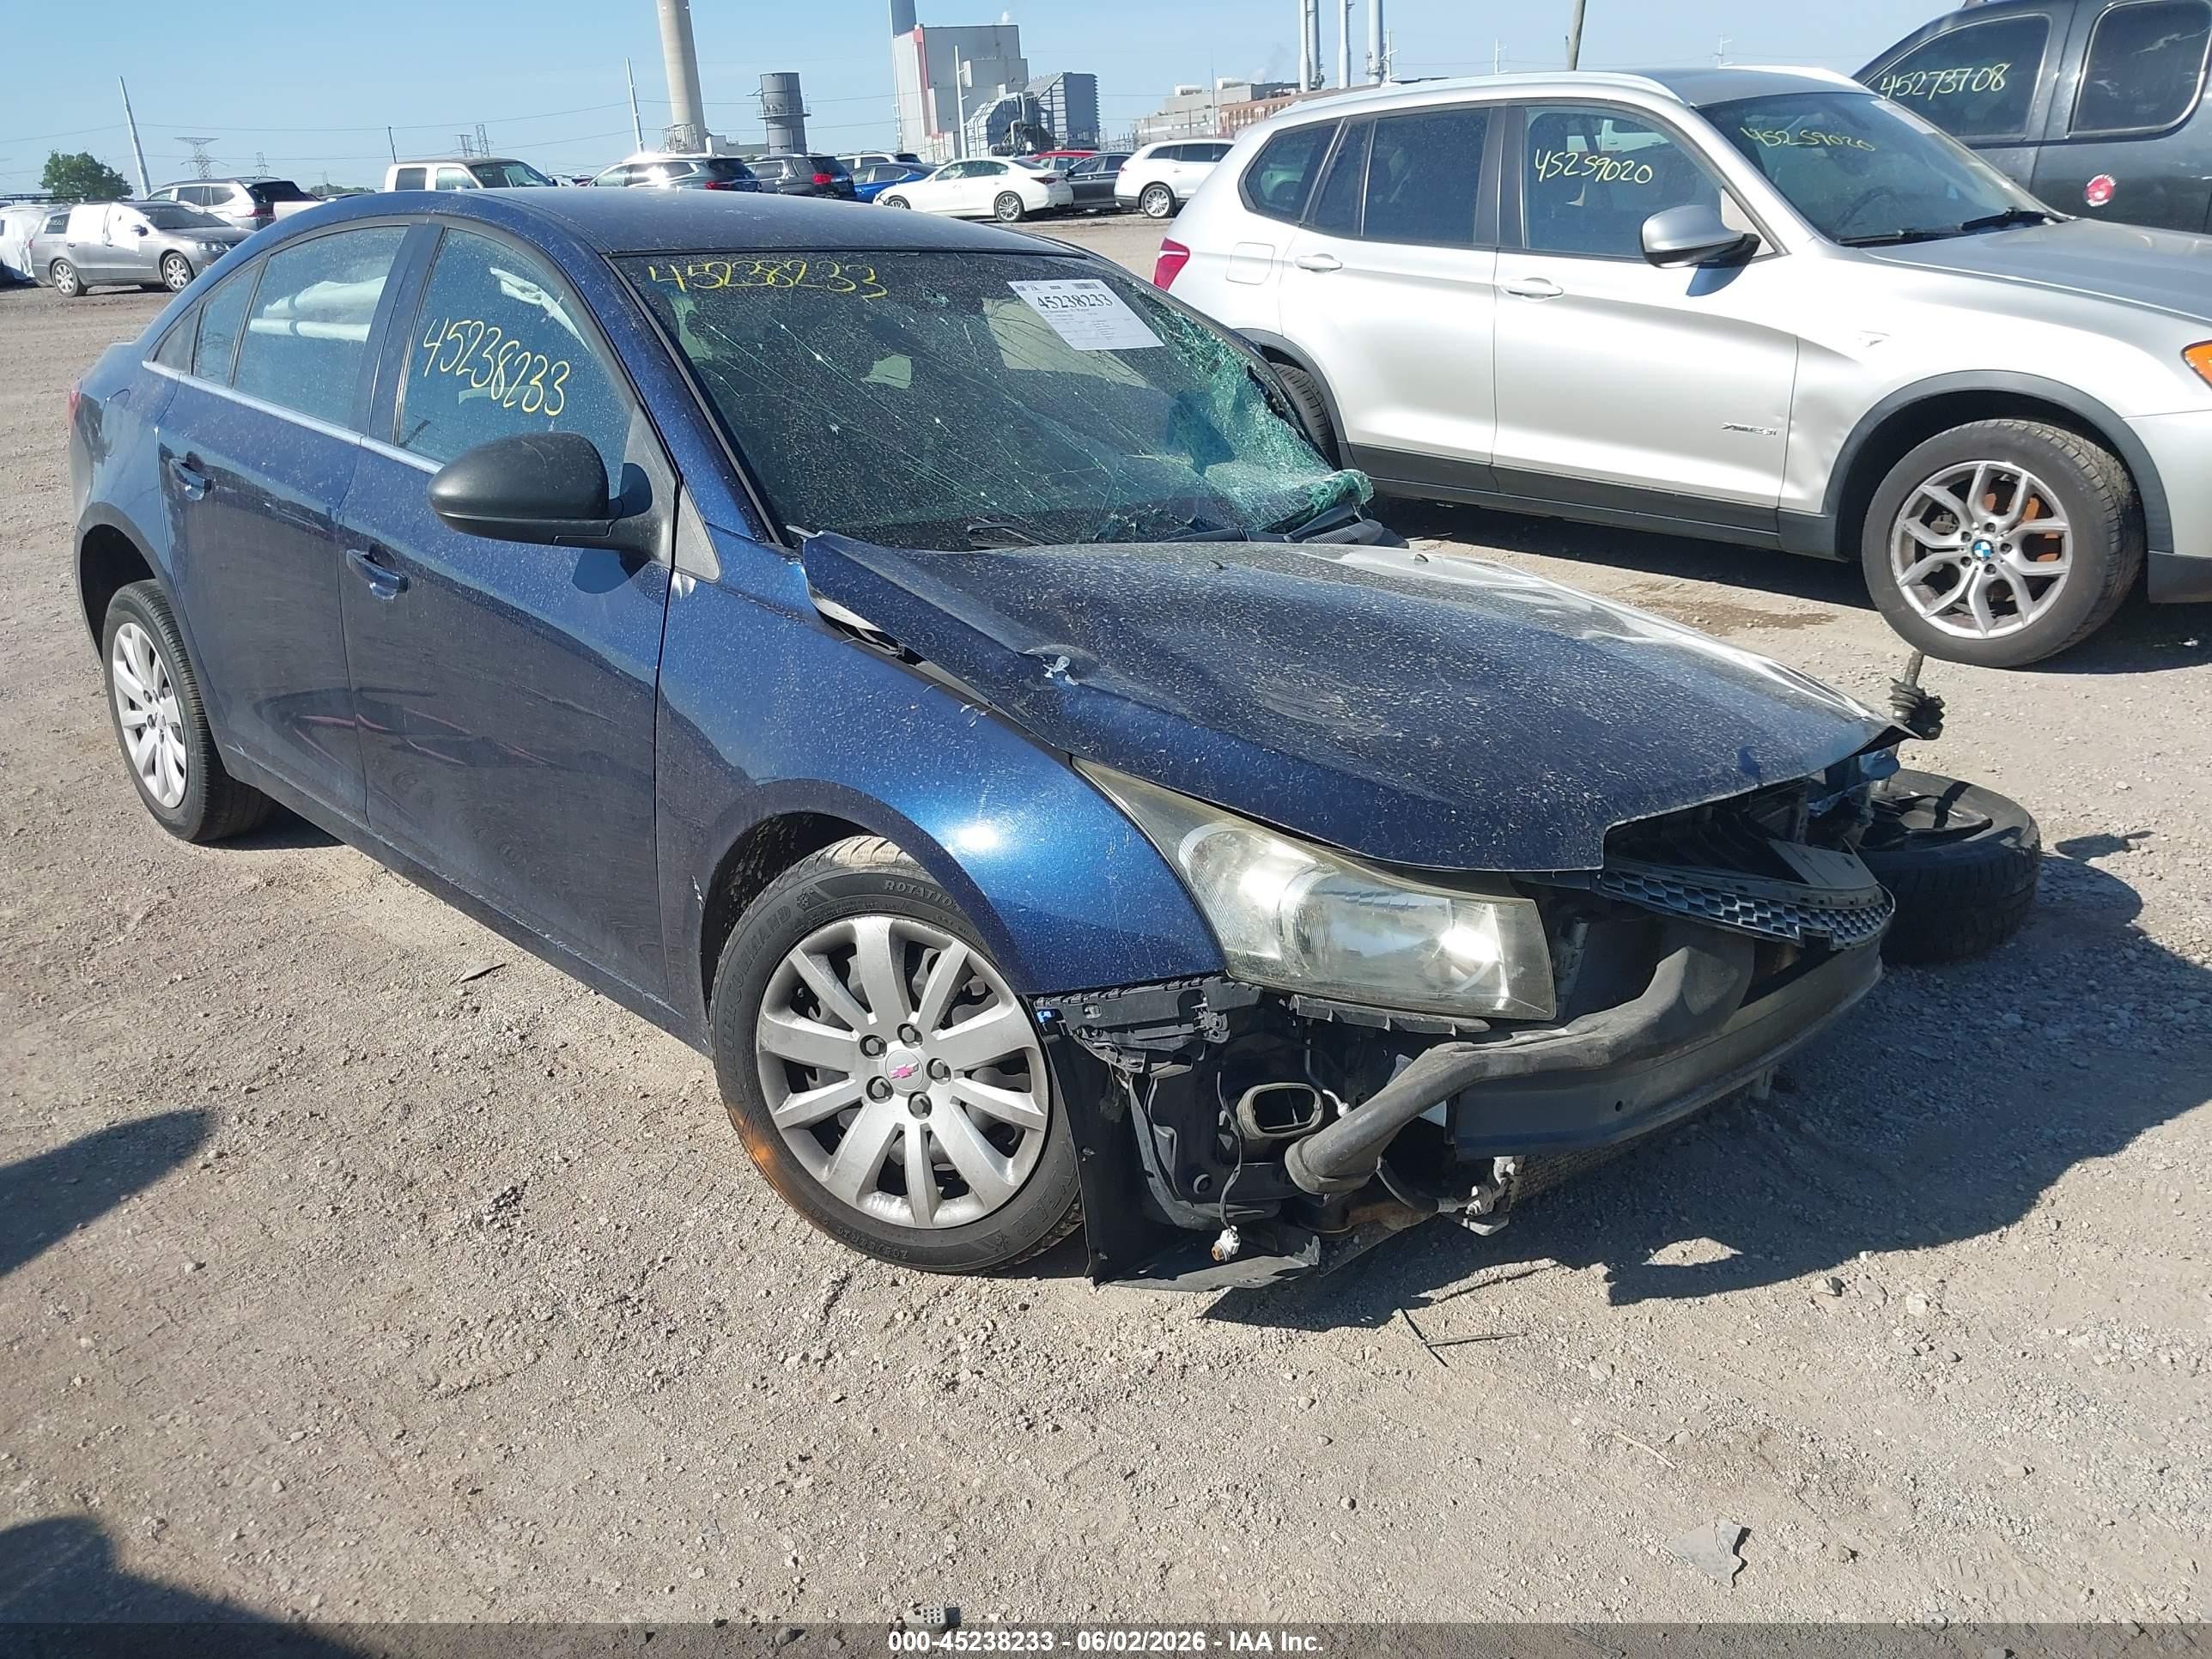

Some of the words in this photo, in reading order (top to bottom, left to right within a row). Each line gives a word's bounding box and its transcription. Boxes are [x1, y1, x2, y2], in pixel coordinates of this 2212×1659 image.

[1880, 62, 2012, 100] 45273708
[1740, 125, 1876, 152] 45259020
[1535, 149, 1654, 185] 45259020
[647, 259, 889, 305] 45238233
[1036, 293, 1114, 310] 45238233
[423, 316, 570, 416] 45238233
